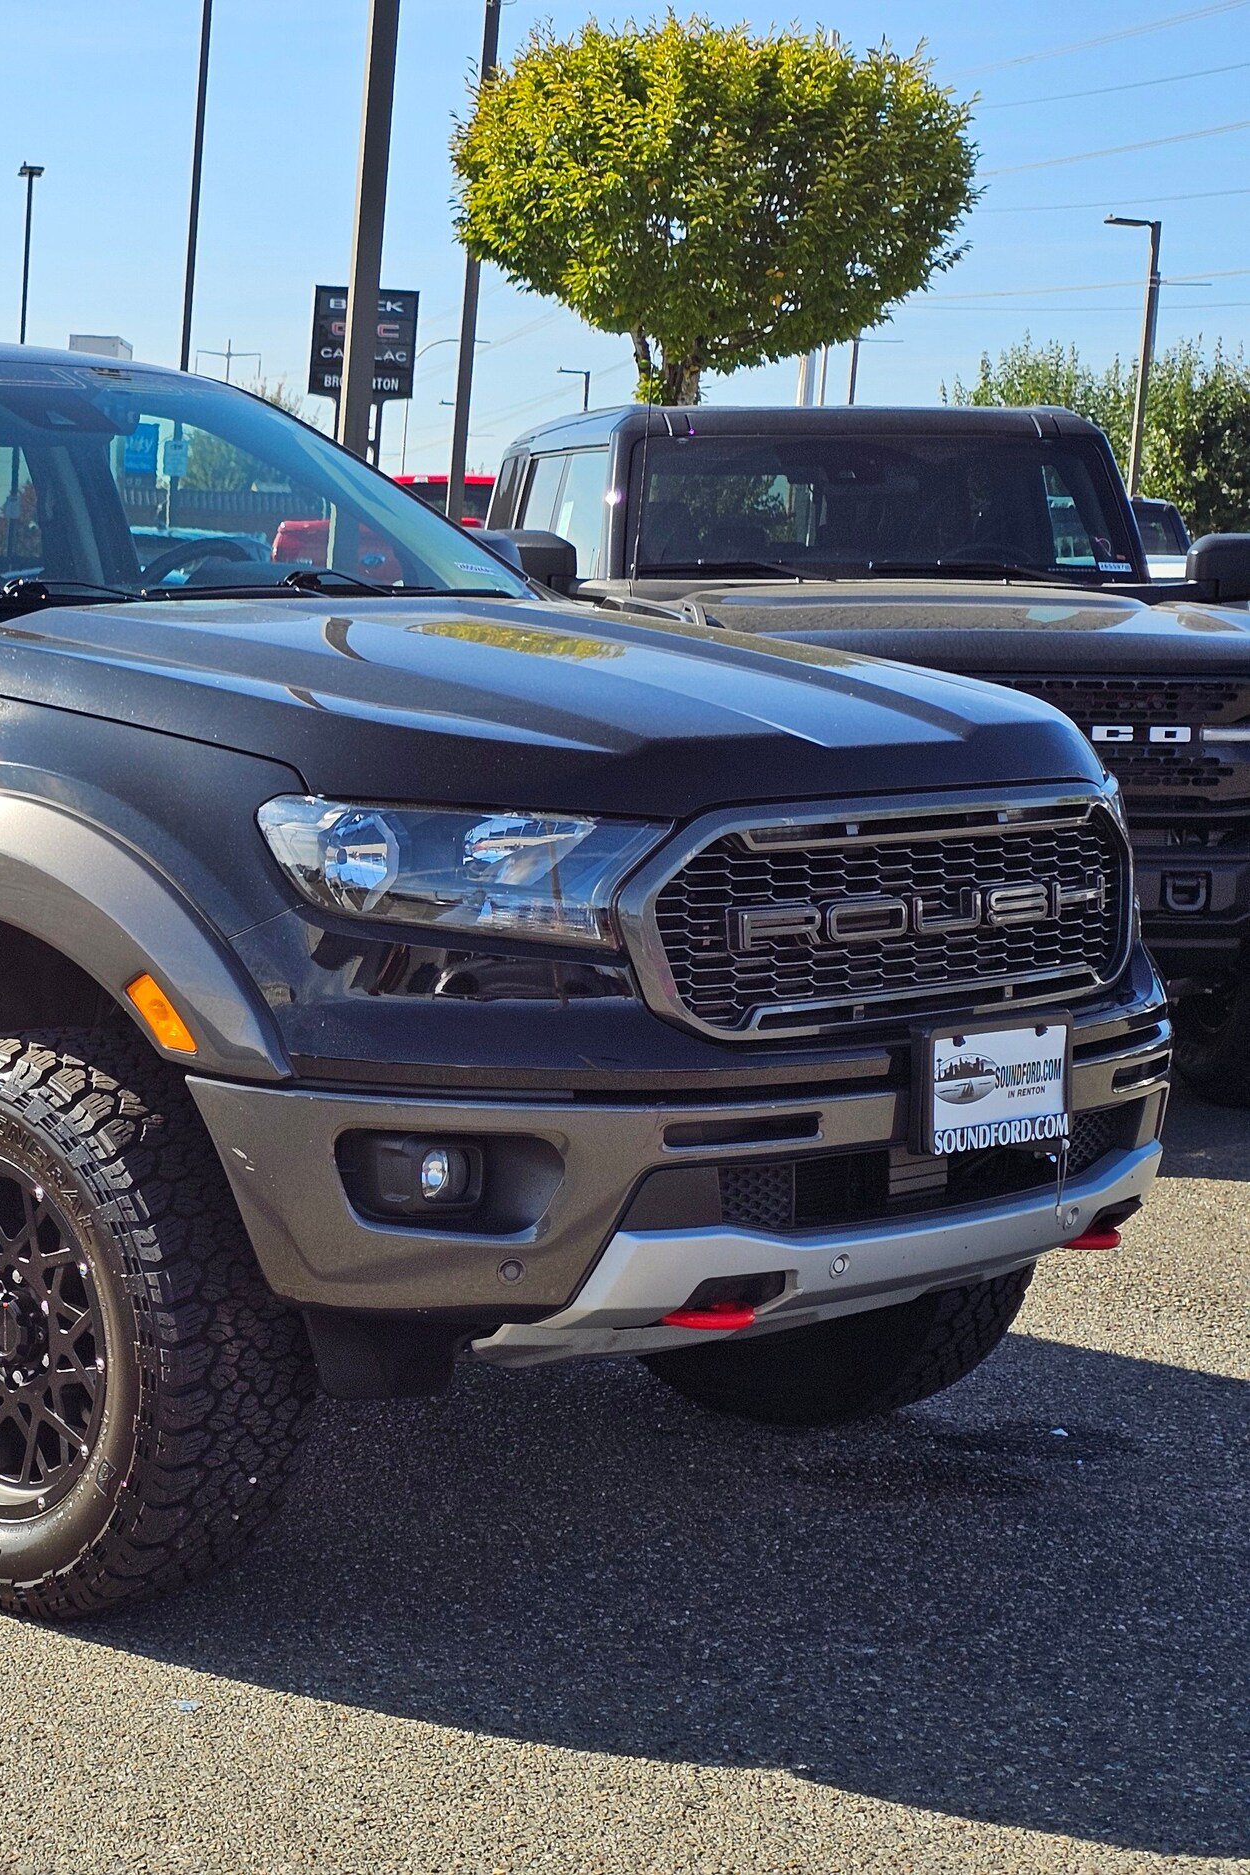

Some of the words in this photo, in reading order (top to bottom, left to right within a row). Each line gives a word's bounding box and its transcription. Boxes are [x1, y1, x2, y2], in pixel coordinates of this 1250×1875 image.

[331, 321, 400, 338] GC
[320, 347, 407, 362] CALAC
[726, 872, 1106, 951] ROUSH
[994, 1058, 1062, 1089] SOUNDFORD.COM
[1007, 1088, 1015, 1099] IN
[1017, 1085, 1046, 1097] RENTON
[934, 1113, 1069, 1155] SOUNDFORD.COM
